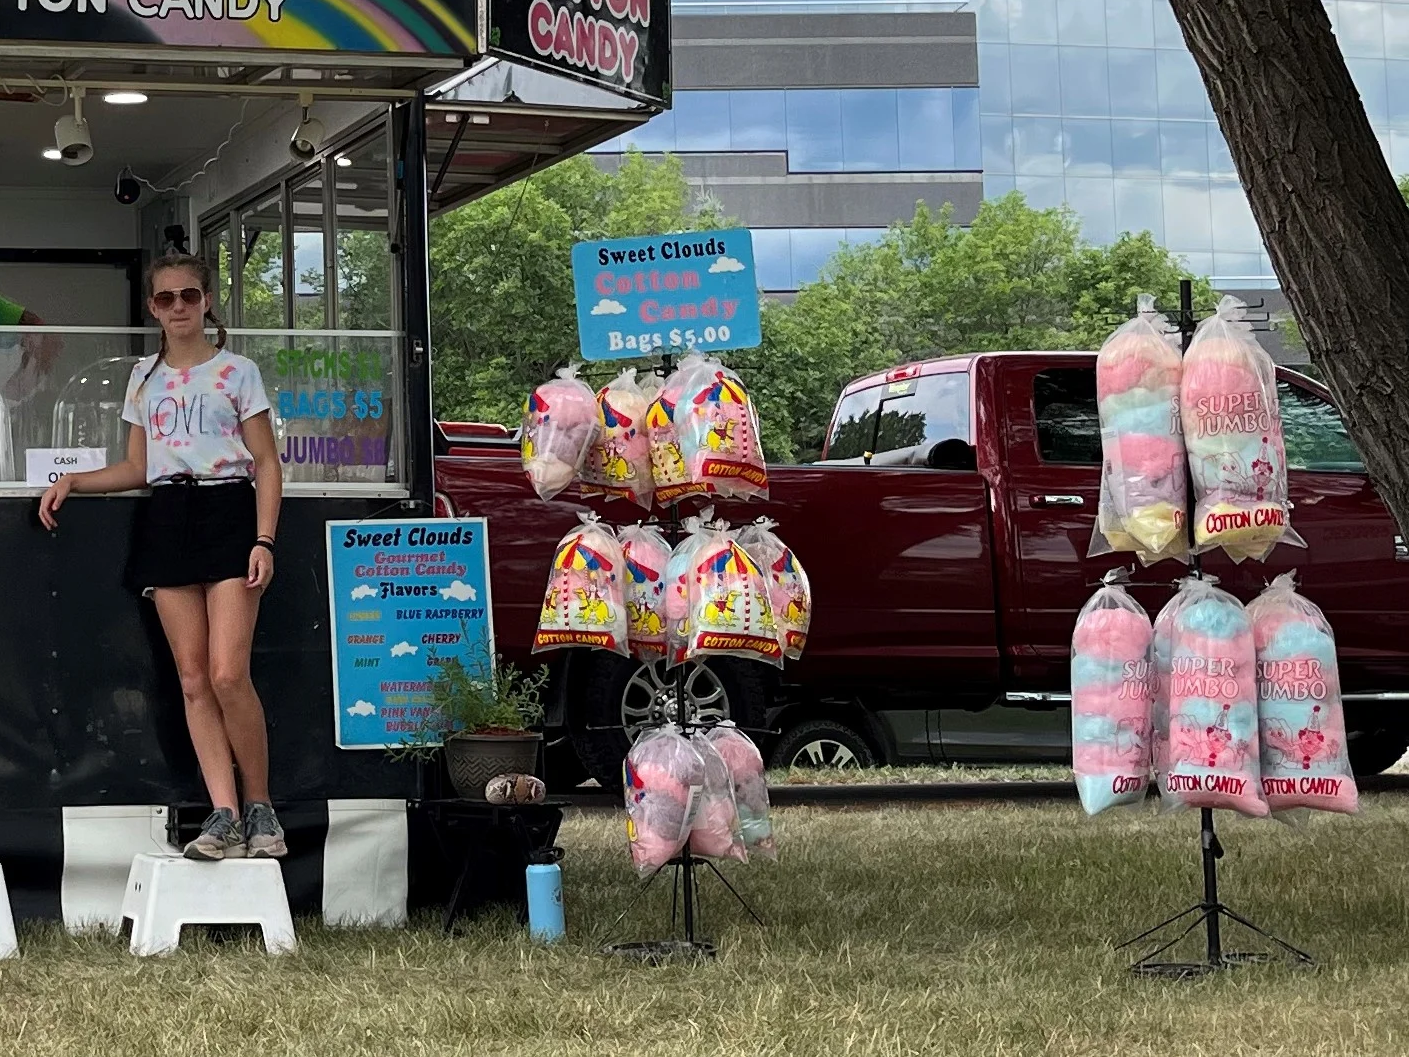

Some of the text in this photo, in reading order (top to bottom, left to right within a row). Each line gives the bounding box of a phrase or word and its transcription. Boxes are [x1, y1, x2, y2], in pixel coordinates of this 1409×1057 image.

[598, 238, 726, 265] Sweet Clouds
[595, 270, 700, 295] Cotton
[639, 296, 738, 323] Candy
[608, 325, 731, 352] Bags $5.00
[276, 349, 351, 380] STICKS
[278, 389, 383, 421] BAGS $5
[149, 393, 211, 440] LOVE
[1198, 412, 1270, 439] JUMBO
[281, 435, 355, 464] JUMBO
[54, 457, 78, 466] CASH
[708, 463, 740, 475] COTTON
[1206, 511, 1251, 533] COTTON
[343, 526, 473, 548] Sweet Clouds
[374, 551, 446, 564] Gourmet
[354, 562, 467, 577] Cotton Candy
[380, 582, 438, 599] Flavors
[396, 608, 484, 620] BLUE RASPBERRY
[347, 634, 385, 644] ORANGE
[421, 633, 462, 644] CHERRY
[538, 634, 608, 645] COTTON CANDY
[703, 636, 745, 648] COTTON
[745, 639, 779, 653] CANDY
[354, 658, 380, 668] MINT
[1172, 656, 1236, 678] SUPER
[1174, 678, 1239, 698] UMBO
[1260, 680, 1327, 701] UMBO
[380, 707, 407, 717] PINK
[1204, 776, 1248, 796] CANDY
[1262, 778, 1343, 796] OTTON CANDY
